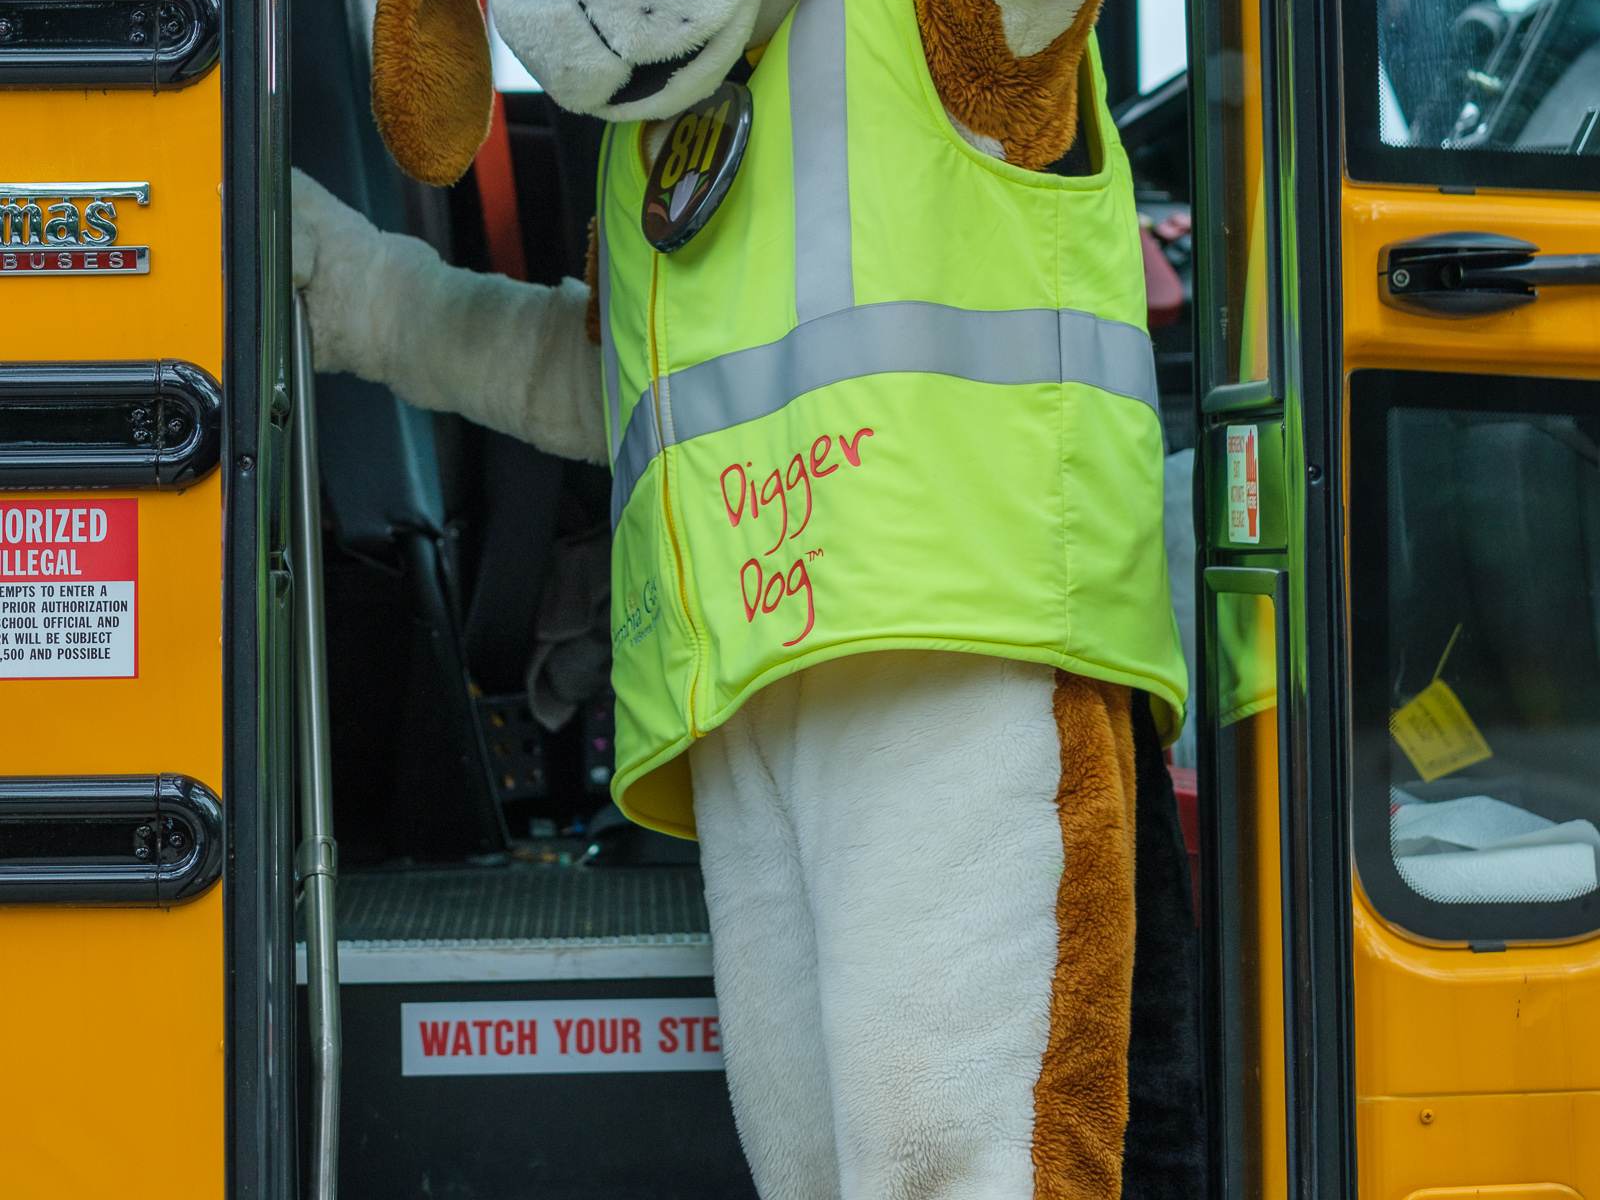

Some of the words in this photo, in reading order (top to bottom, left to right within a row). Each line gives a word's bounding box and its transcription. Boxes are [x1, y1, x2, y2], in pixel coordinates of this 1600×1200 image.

[660, 100, 731, 190] 811
[2, 252, 125, 270] BUSES
[719, 427, 875, 557] Digger
[0, 508, 108, 544] ORIZED
[0, 548, 82, 576] LLEGAL
[41, 585, 55, 598] TO
[60, 585, 95, 598] ENTER
[100, 584, 108, 597] A
[740, 557, 815, 647] Dog
[2, 601, 36, 614] PRIOR
[41, 600, 128, 613] AUTHORIZATION
[0, 617, 38, 629] CHOOL
[43, 616, 92, 629] OFFICIAL
[97, 616, 120, 628] AND
[15, 632, 41, 645] WILL
[46, 632, 60, 645] BE
[65, 631, 112, 644] SUBJECT
[30, 648, 52, 661] AND
[57, 647, 111, 660] POSSIBLE
[419, 1019, 538, 1057] WATCH
[553, 1018, 642, 1055] YOUR
[658, 1016, 721, 1053] STE
